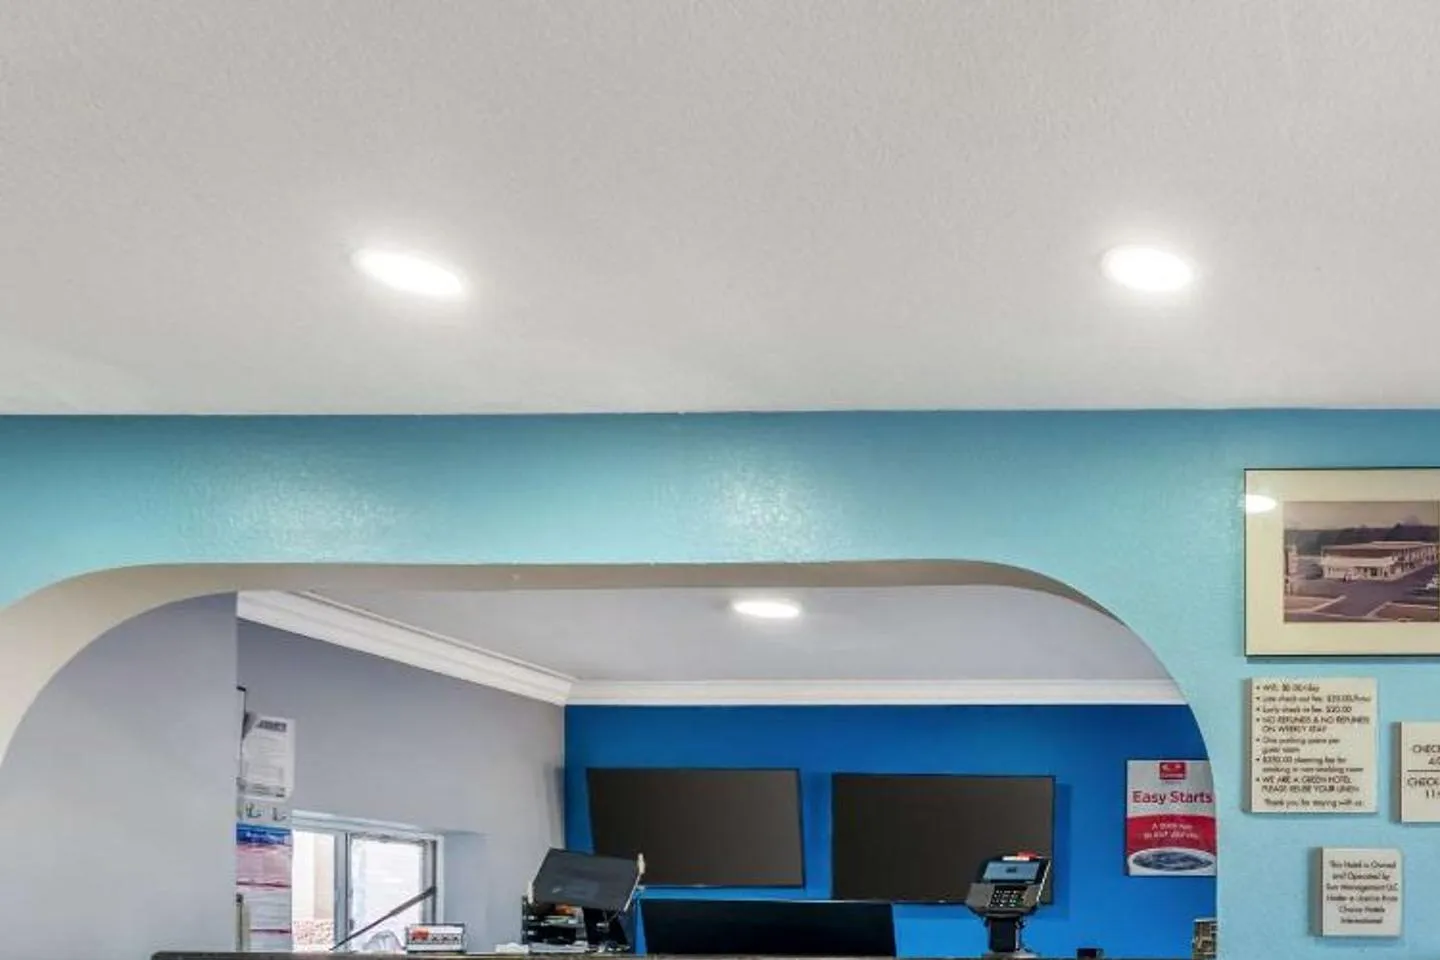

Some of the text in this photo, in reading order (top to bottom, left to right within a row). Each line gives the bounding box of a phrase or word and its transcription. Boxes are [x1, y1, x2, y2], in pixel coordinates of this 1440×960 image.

[1262, 715, 1276, 724] NO
[1321, 715, 1335, 724] NO
[1132, 790, 1213, 805] Easy Starts
